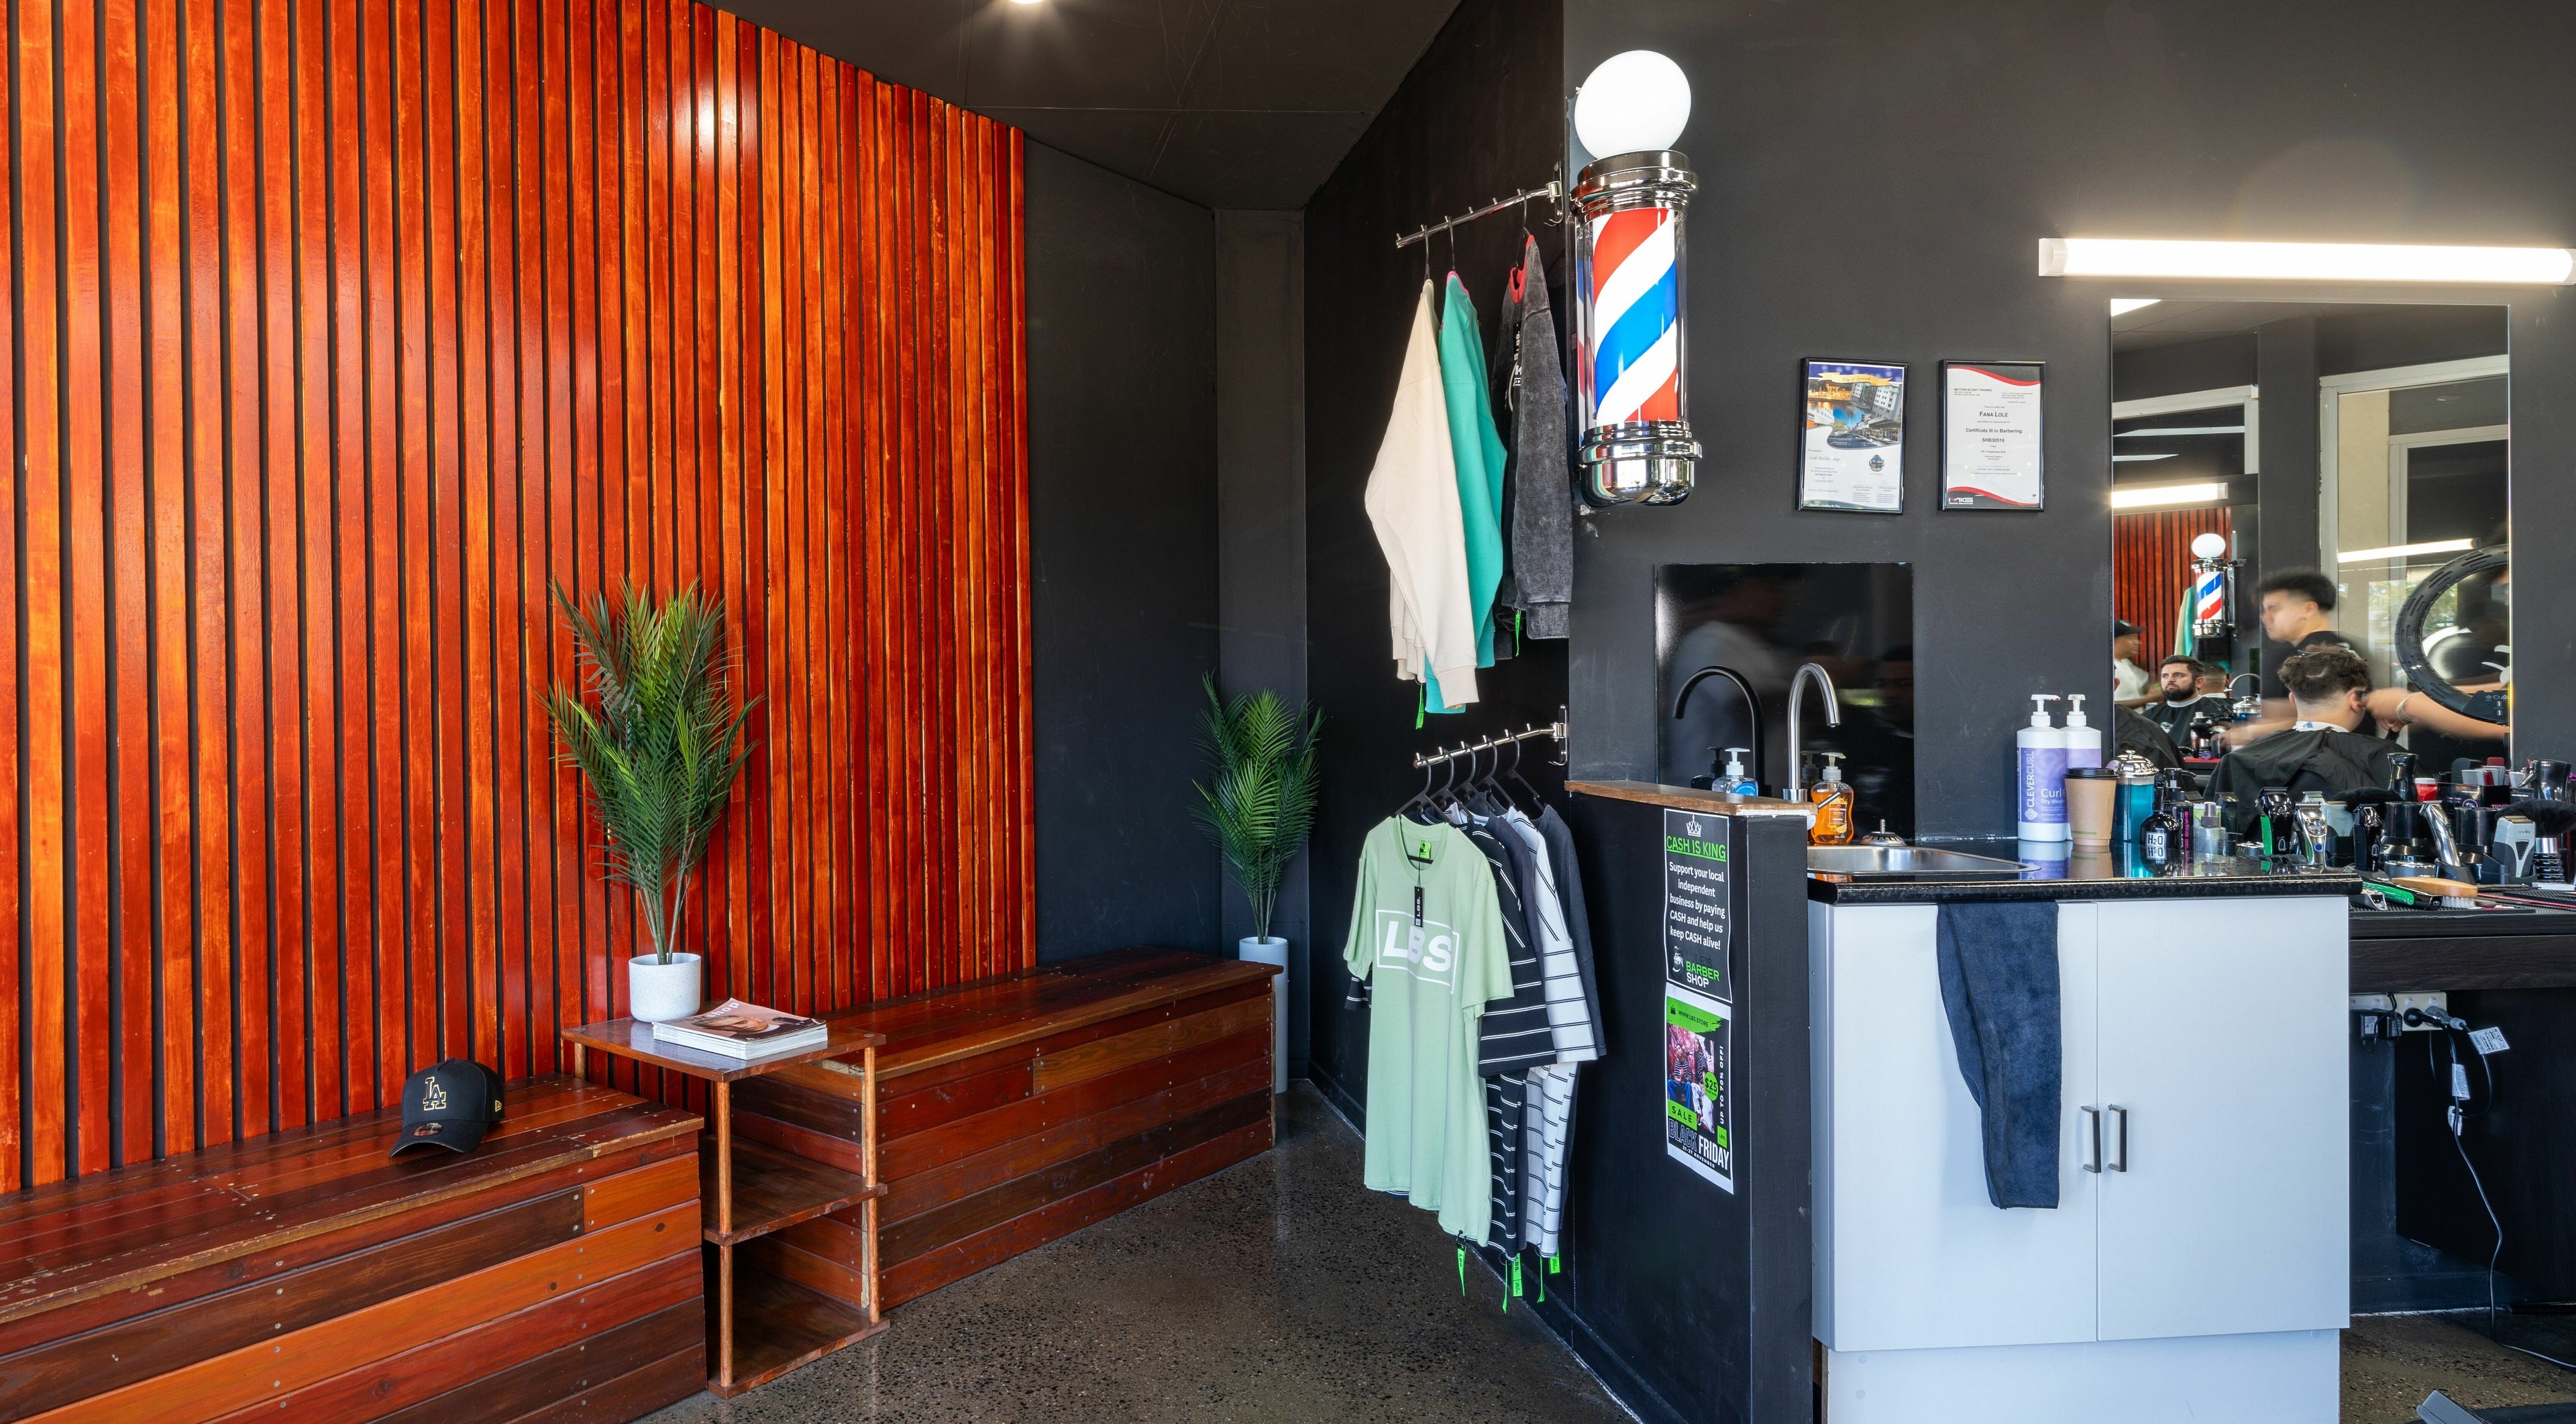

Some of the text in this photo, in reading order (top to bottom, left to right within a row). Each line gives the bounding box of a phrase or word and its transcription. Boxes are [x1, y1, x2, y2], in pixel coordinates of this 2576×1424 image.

[2027, 751, 2035, 808] CLEVERCURL
[2041, 787, 2061, 798] Curl
[1666, 835, 1726, 859] CASH IS KING
[1669, 861, 1725, 883] Support your local
[1678, 878, 1716, 897] independent
[1670, 892, 1725, 920] business by paying
[1670, 910, 1723, 933] CASH and help us
[1383, 921, 1452, 972] LBS
[1670, 925, 1721, 950] keep CASH alive!
[1686, 961, 1720, 982] BARBER
[1686, 971, 1709, 988] SHOP
[423, 1076, 447, 1111] LA
[1705, 1077, 1717, 1093] $25
[1719, 1095, 1724, 1107] TO
[1672, 1105, 1693, 1124] SALE
[1719, 1111, 1725, 1125] UP
[1668, 1118, 1729, 1170] BLACK FRIDAY
[1693, 1152, 1715, 1168] NOVEMBER
